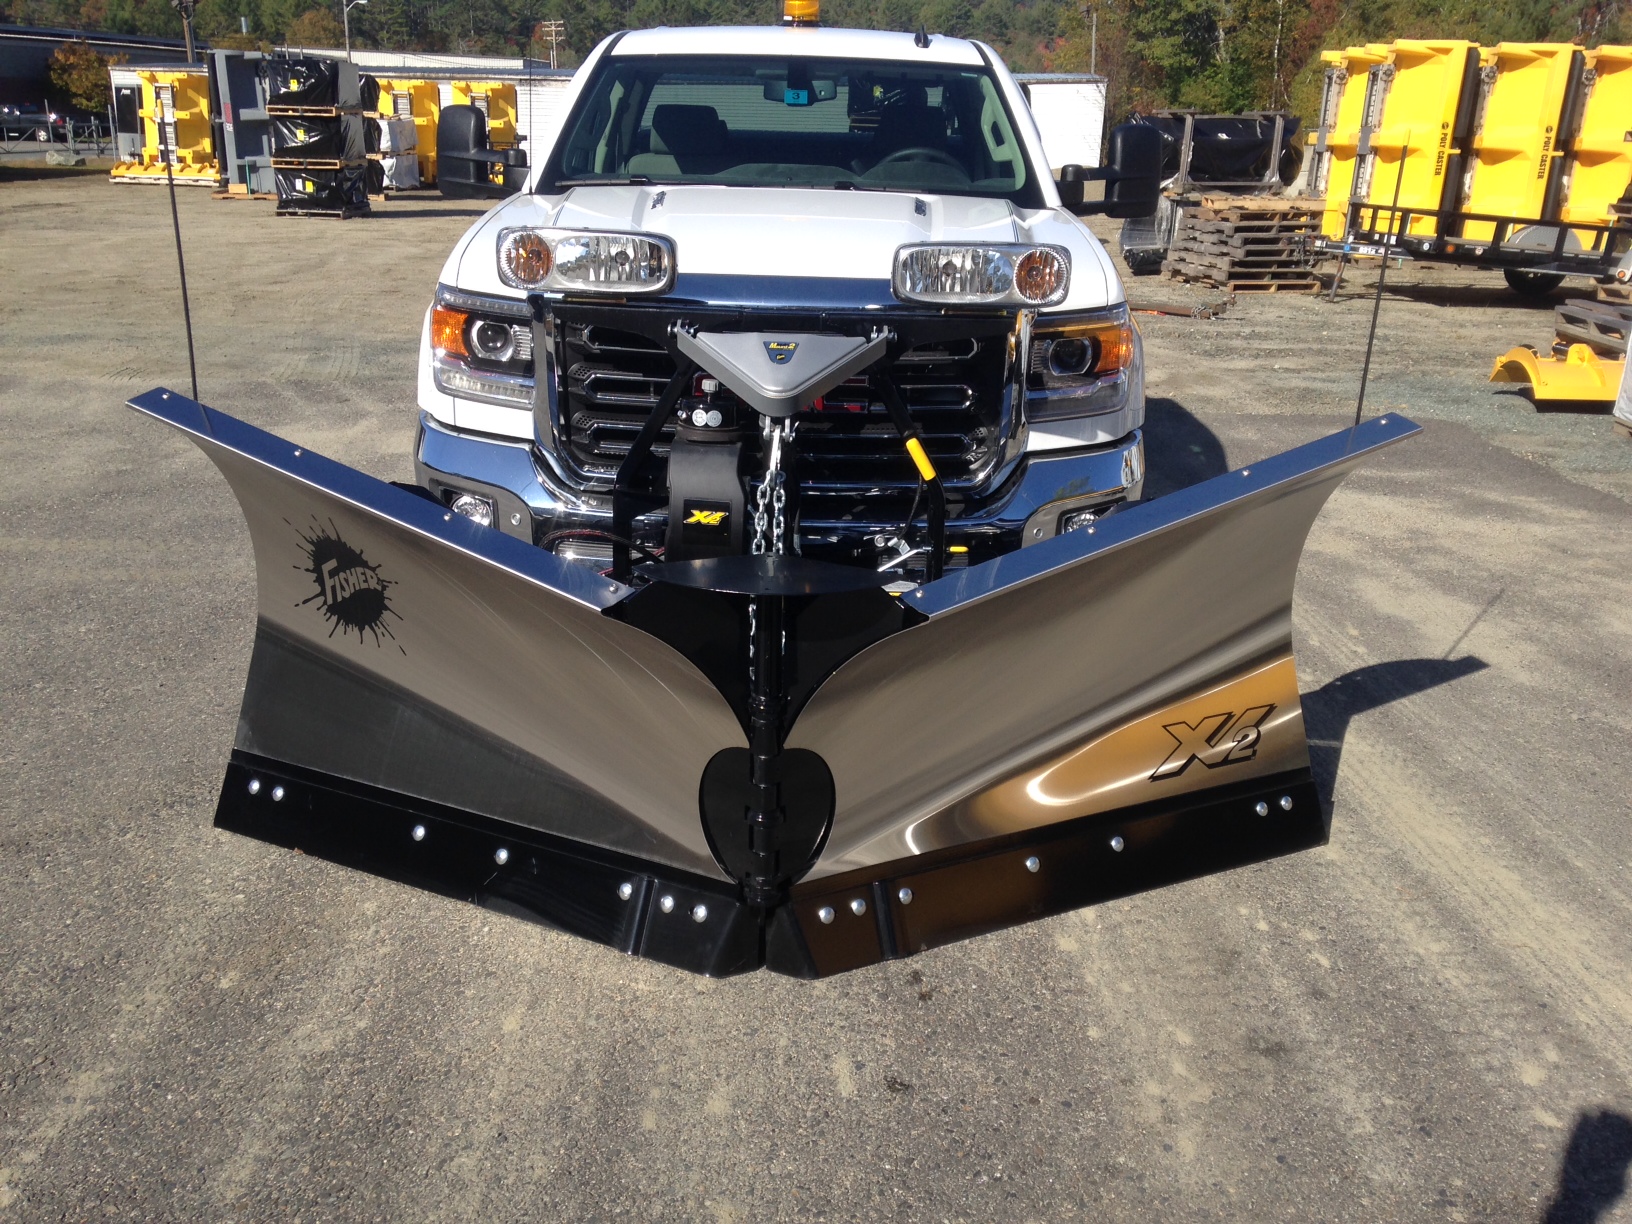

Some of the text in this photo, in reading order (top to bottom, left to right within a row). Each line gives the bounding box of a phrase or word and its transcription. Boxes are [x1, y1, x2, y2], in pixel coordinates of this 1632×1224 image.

[1435, 132, 1448, 175] POLY CASTER
[1537, 136, 1551, 179] POLY CASTER
[321, 558, 382, 606] FISHER
